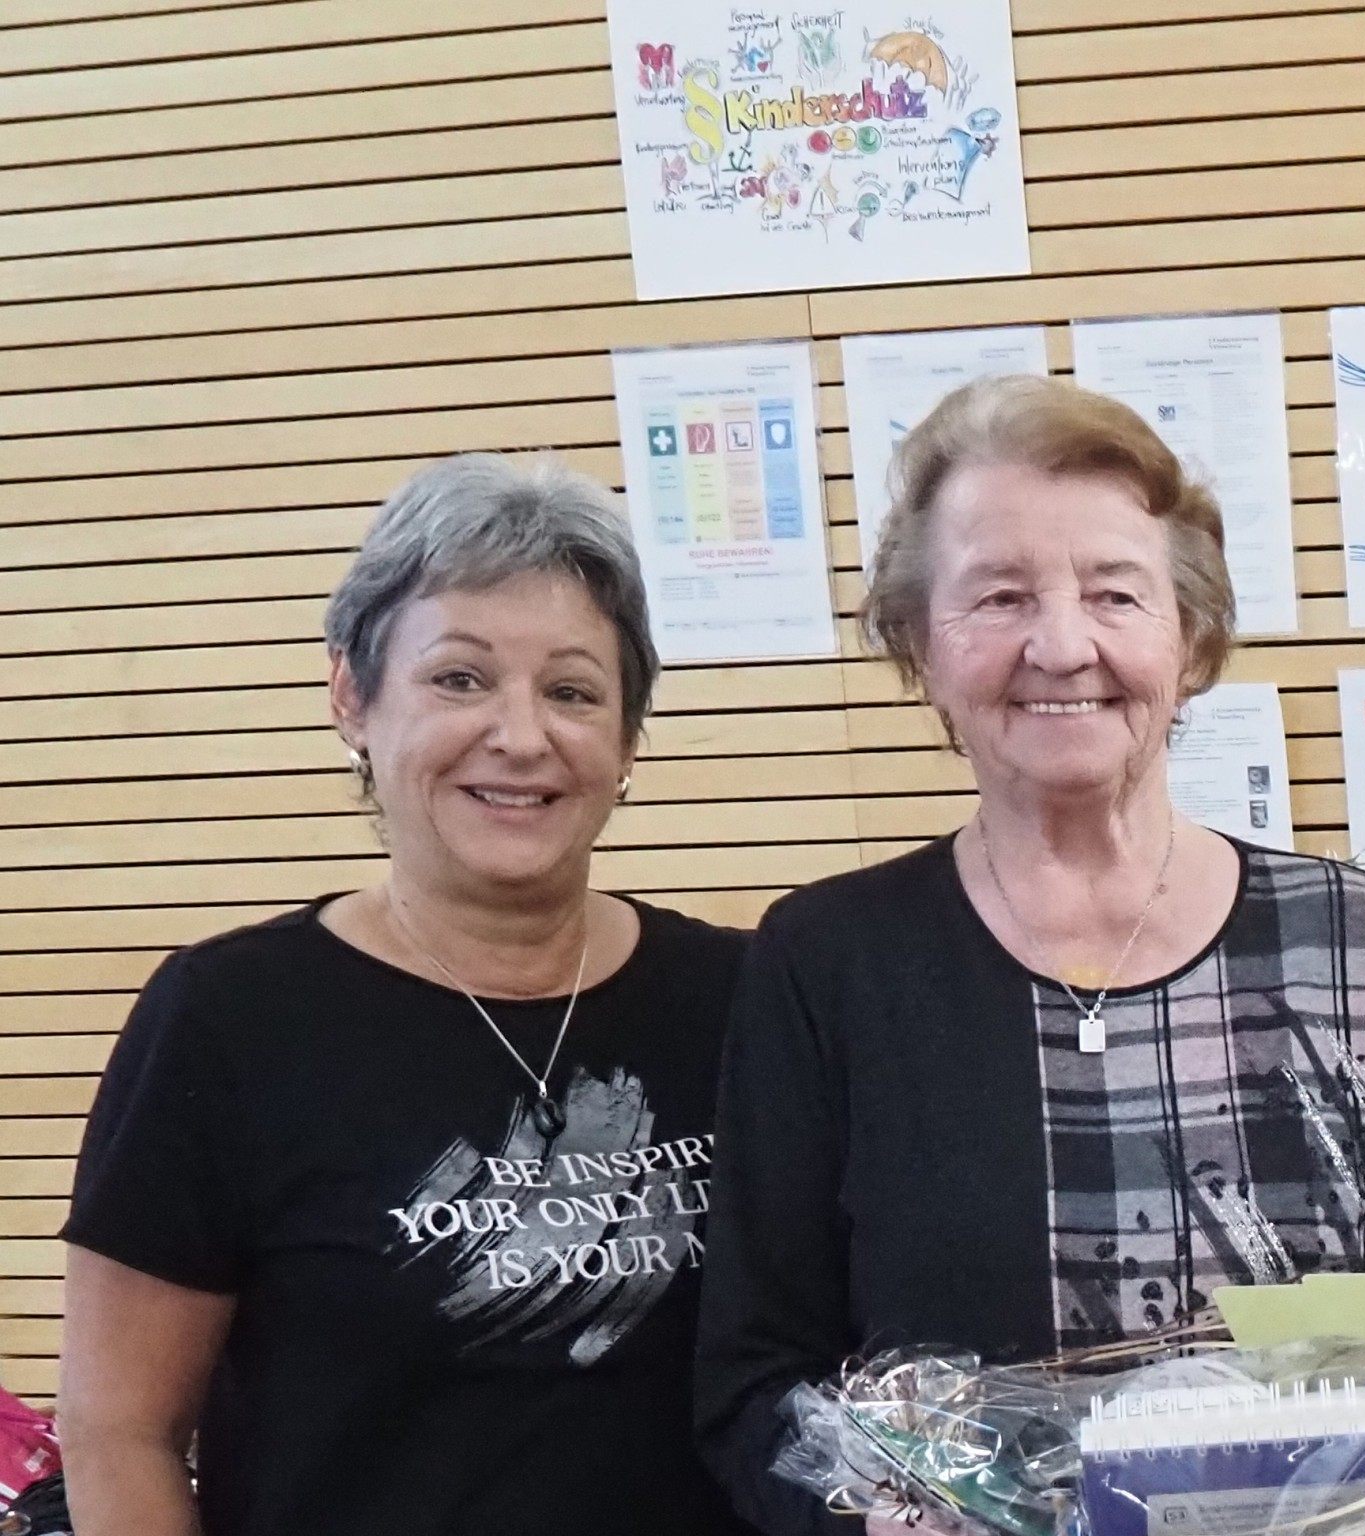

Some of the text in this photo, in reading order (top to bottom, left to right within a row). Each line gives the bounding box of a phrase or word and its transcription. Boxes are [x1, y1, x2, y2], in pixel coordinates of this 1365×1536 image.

[723, 76, 929, 134] Kinderschutz
[484, 1133, 715, 1187] BE INSPIR
[388, 1198, 529, 1244] YOUR
[538, 1185, 653, 1228] ONLY
[485, 1249, 533, 1290] IS
[545, 1235, 675, 1284] YOUR
